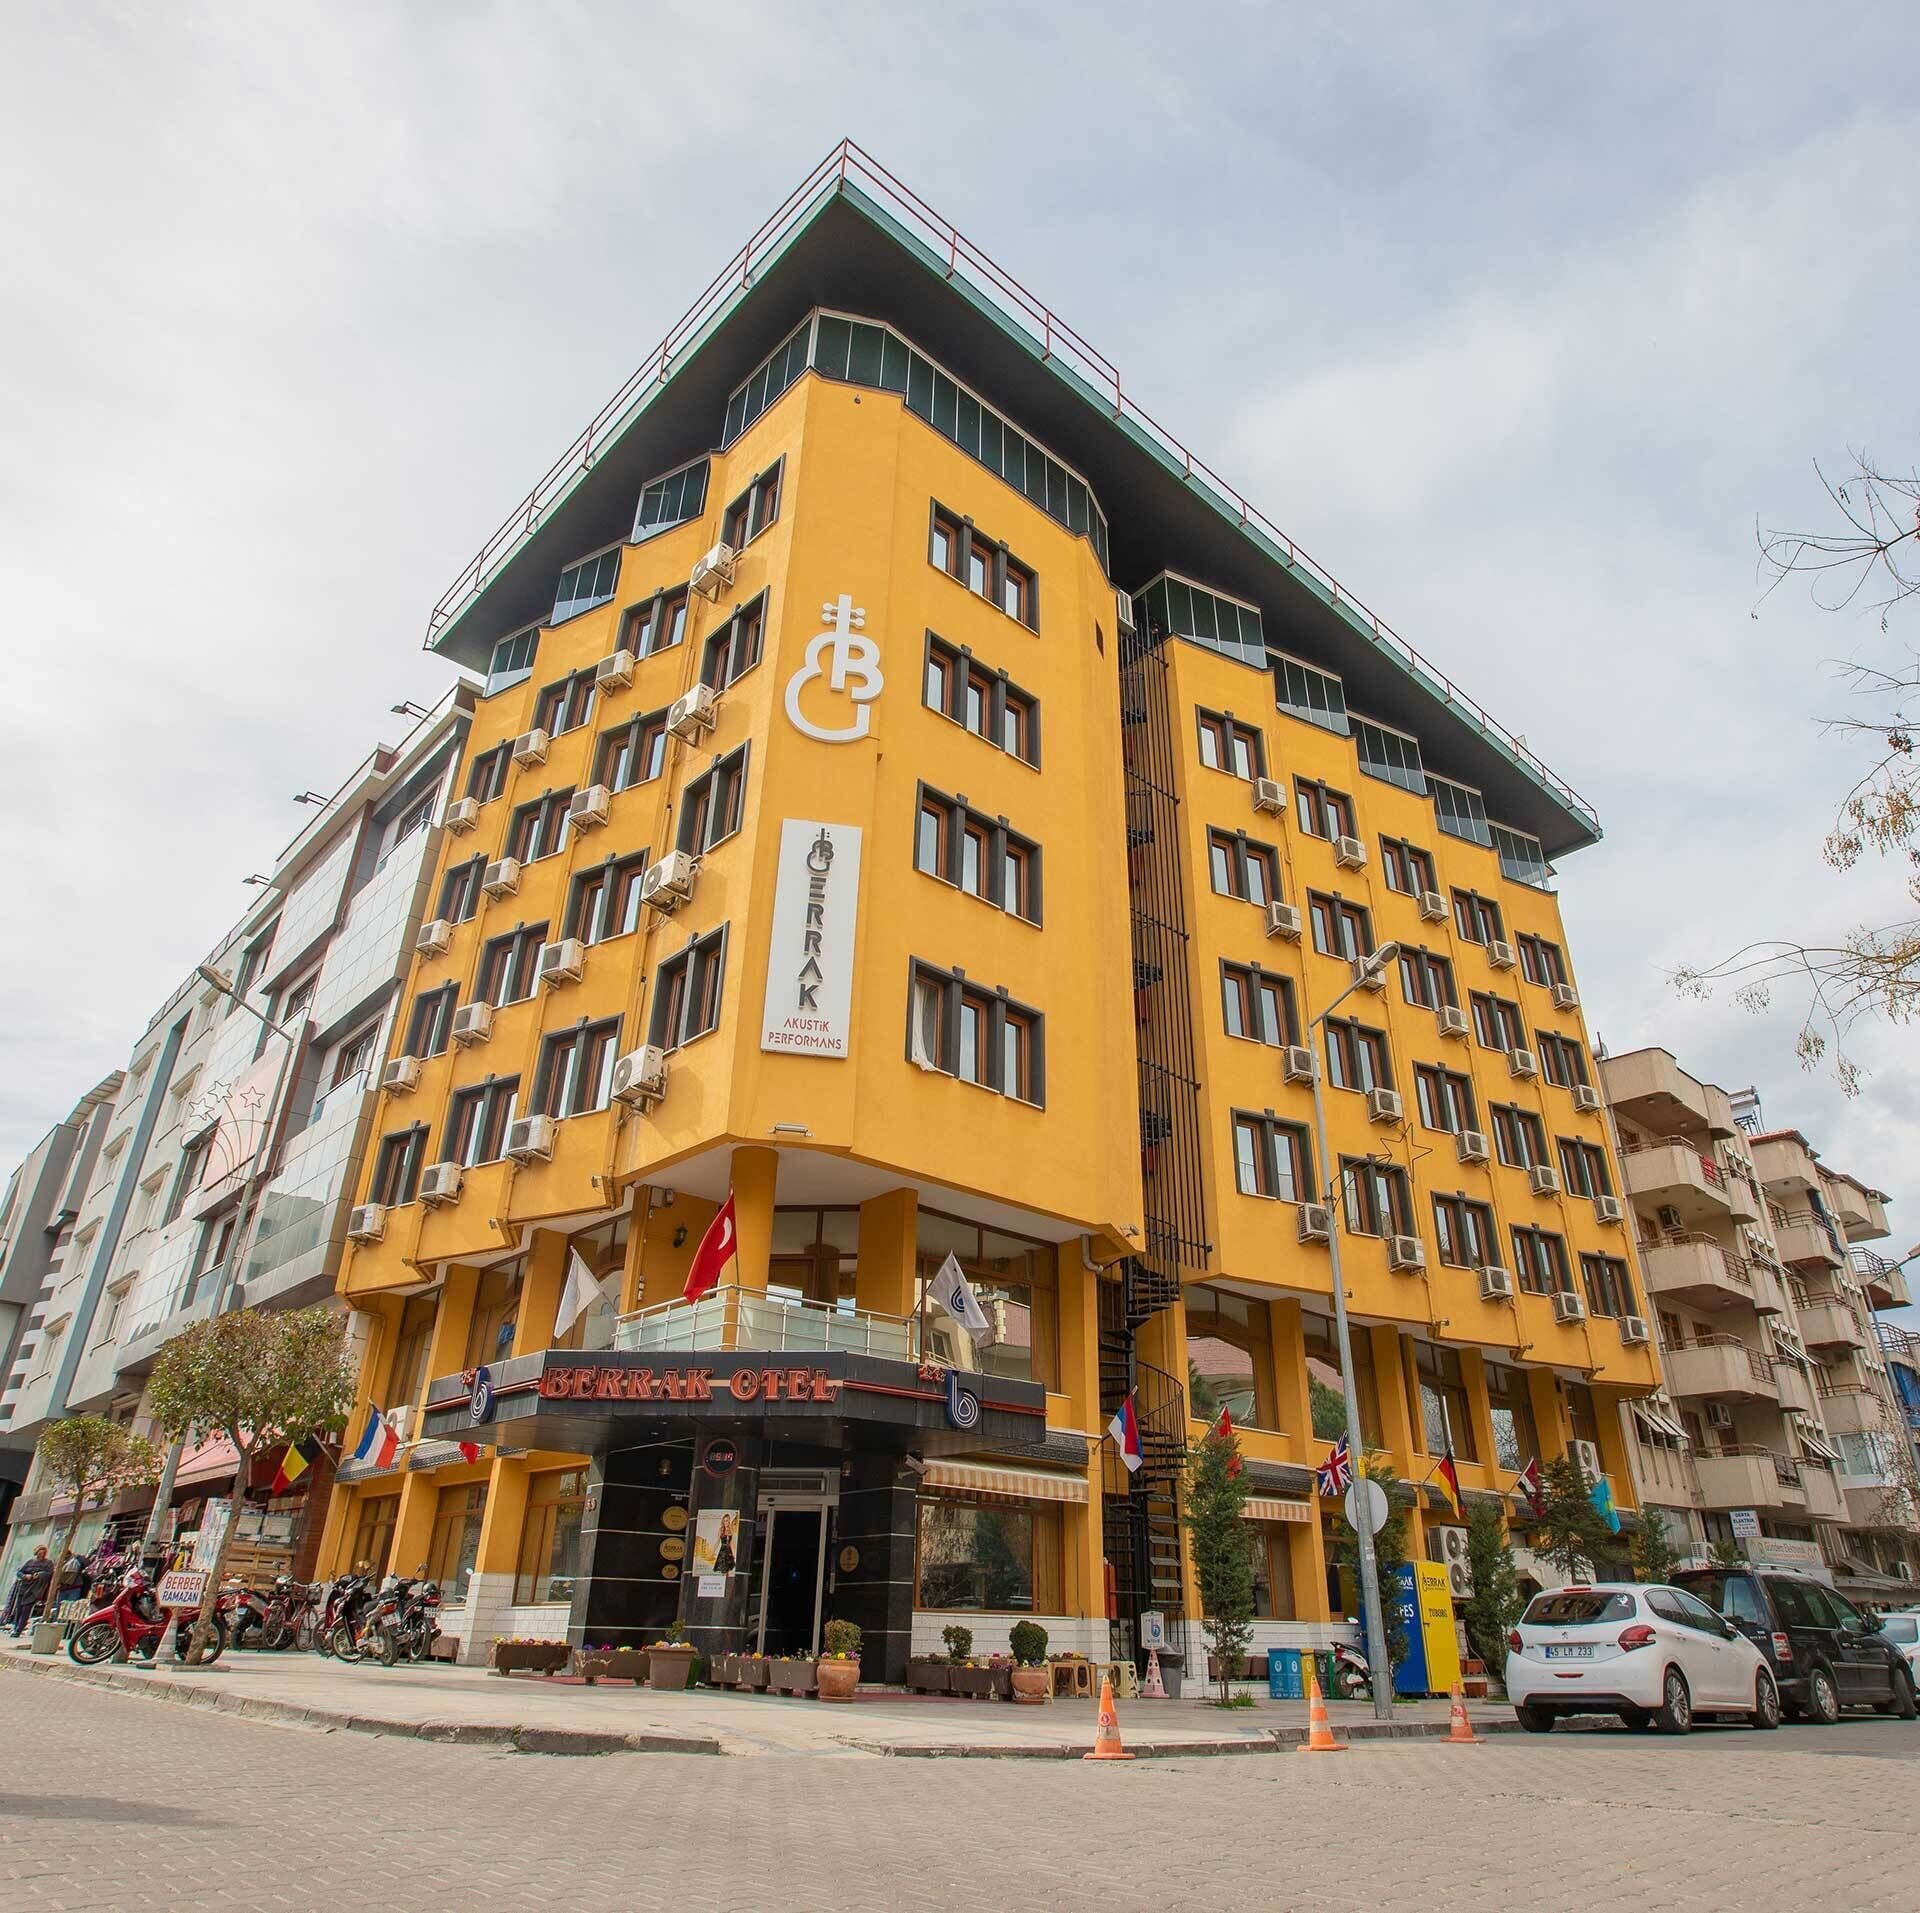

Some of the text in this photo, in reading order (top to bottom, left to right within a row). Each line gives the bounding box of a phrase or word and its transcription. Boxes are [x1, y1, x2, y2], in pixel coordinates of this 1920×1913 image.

[768, 1032, 842, 1049] PERFORMANS
[541, 1366, 838, 1402] BERRAK OTEL
[165, 1576, 202, 1590] BERBER
[162, 1591, 199, 1602] RAMAZAN
[1563, 1646, 1573, 1656] LM
[1577, 1646, 1592, 1656] 233
